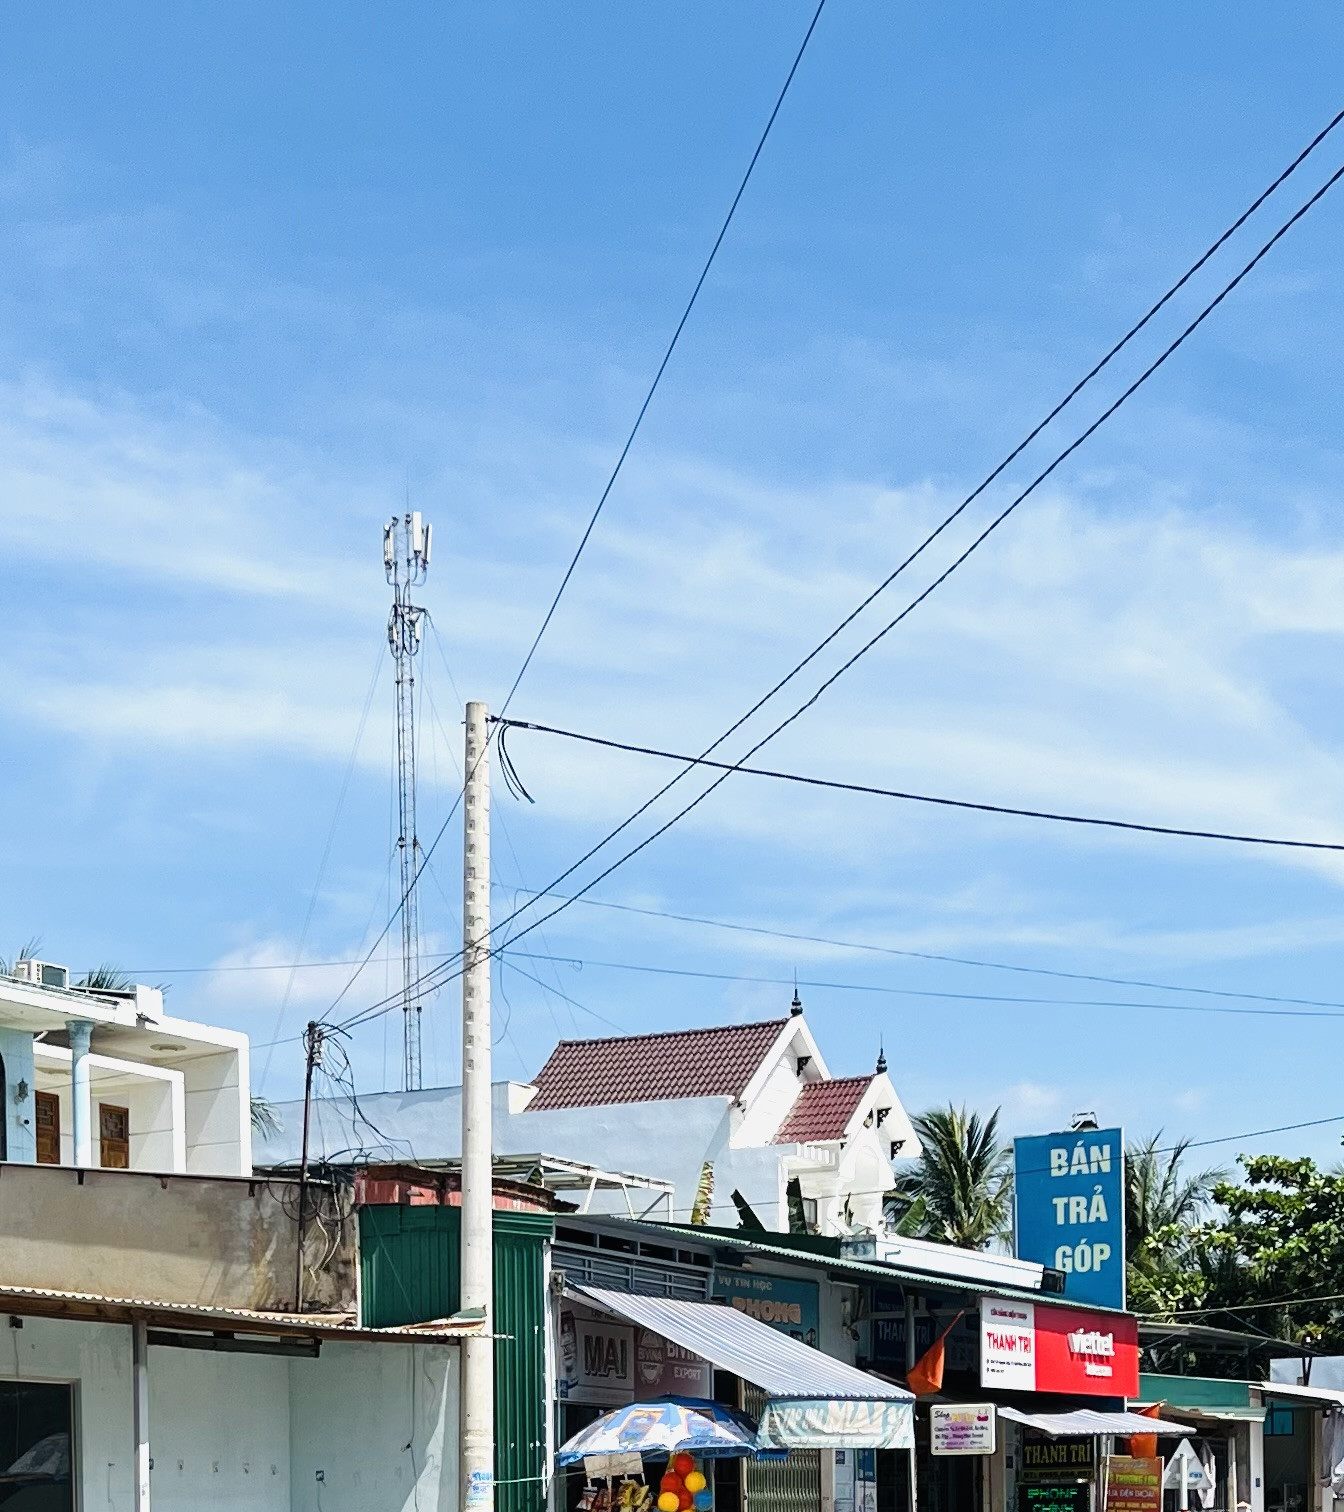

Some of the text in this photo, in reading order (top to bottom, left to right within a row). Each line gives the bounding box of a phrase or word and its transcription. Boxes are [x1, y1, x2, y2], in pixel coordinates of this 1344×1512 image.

[1050, 1140, 1111, 1177] BÁN
[1052, 1184, 1109, 1225] TRẢ
[1054, 1238, 1112, 1274] GÓP
[731, 1296, 802, 1325] PHONG
[877, 1320, 906, 1342] THAN
[987, 1331, 1016, 1351] THANH
[584, 1335, 628, 1379] MAI
[674, 1366, 702, 1381] EXPORT
[1024, 1439, 1091, 1464] THANH TRÍ
